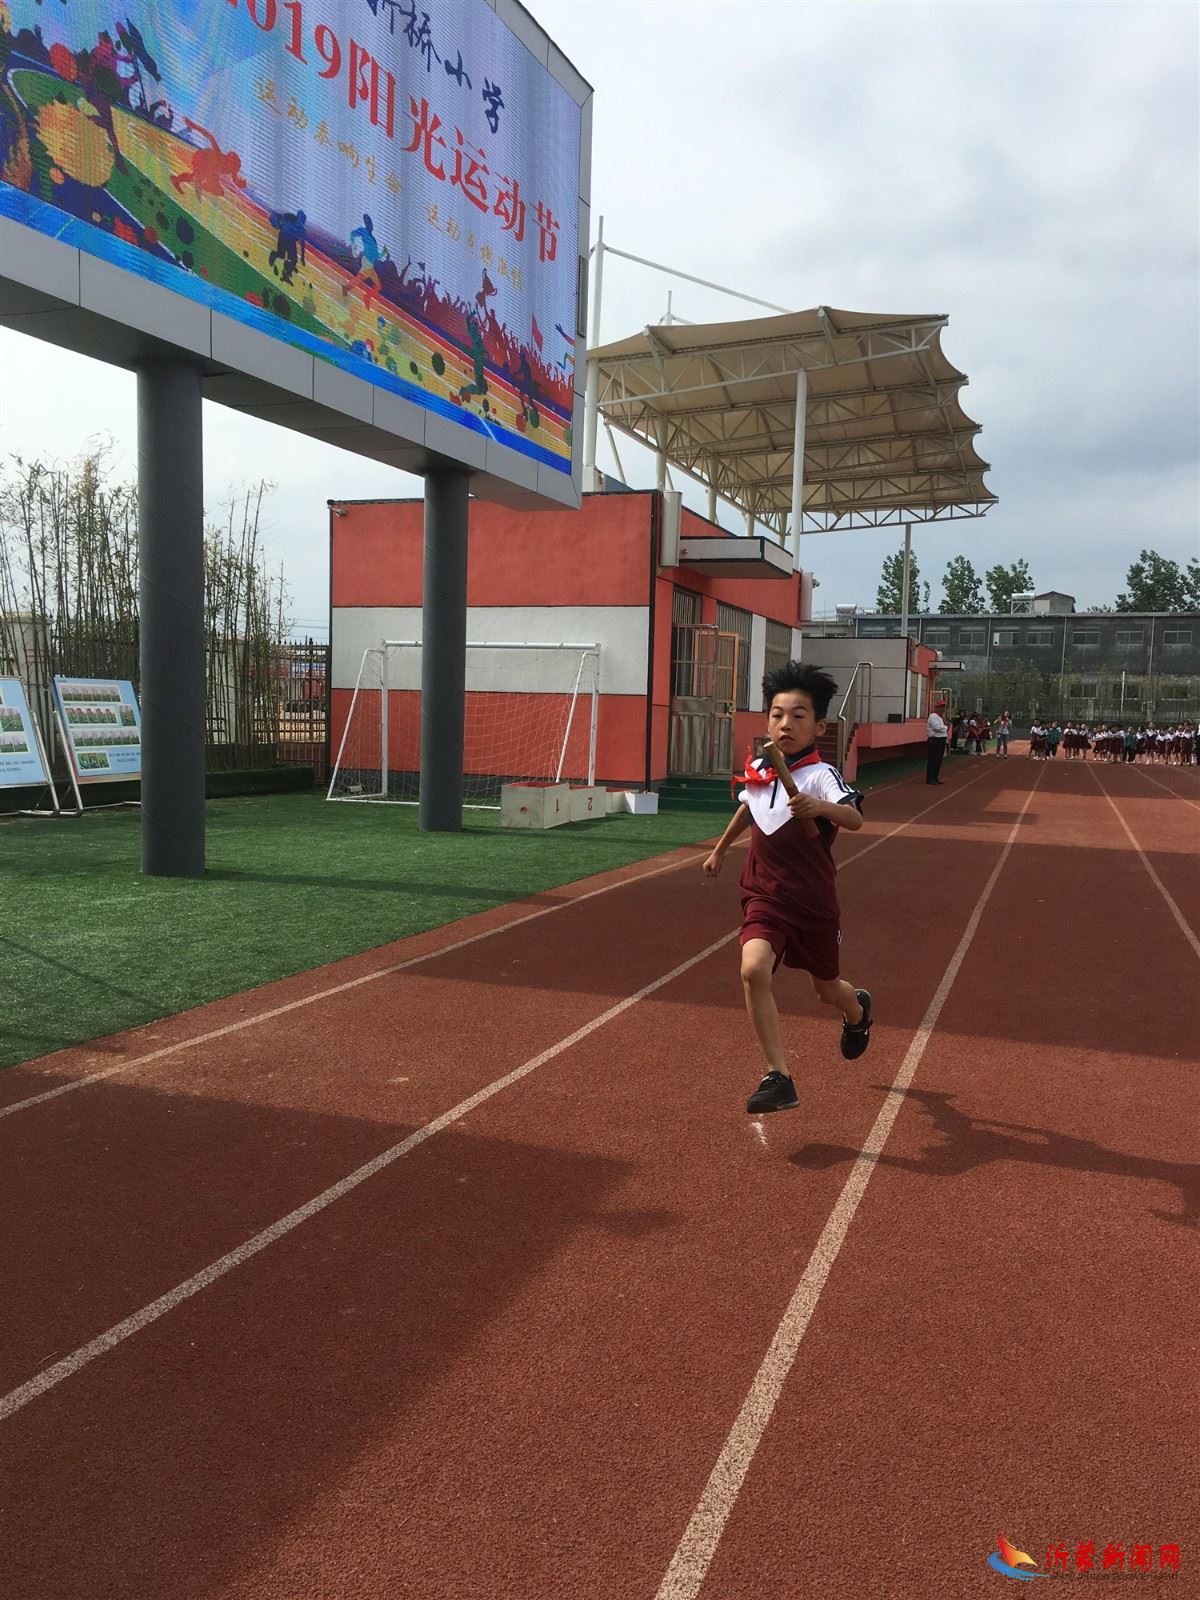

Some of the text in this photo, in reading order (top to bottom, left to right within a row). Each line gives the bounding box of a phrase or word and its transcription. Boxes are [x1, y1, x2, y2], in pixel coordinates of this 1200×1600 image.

[226, 0, 560, 262] 019阳光运动节
